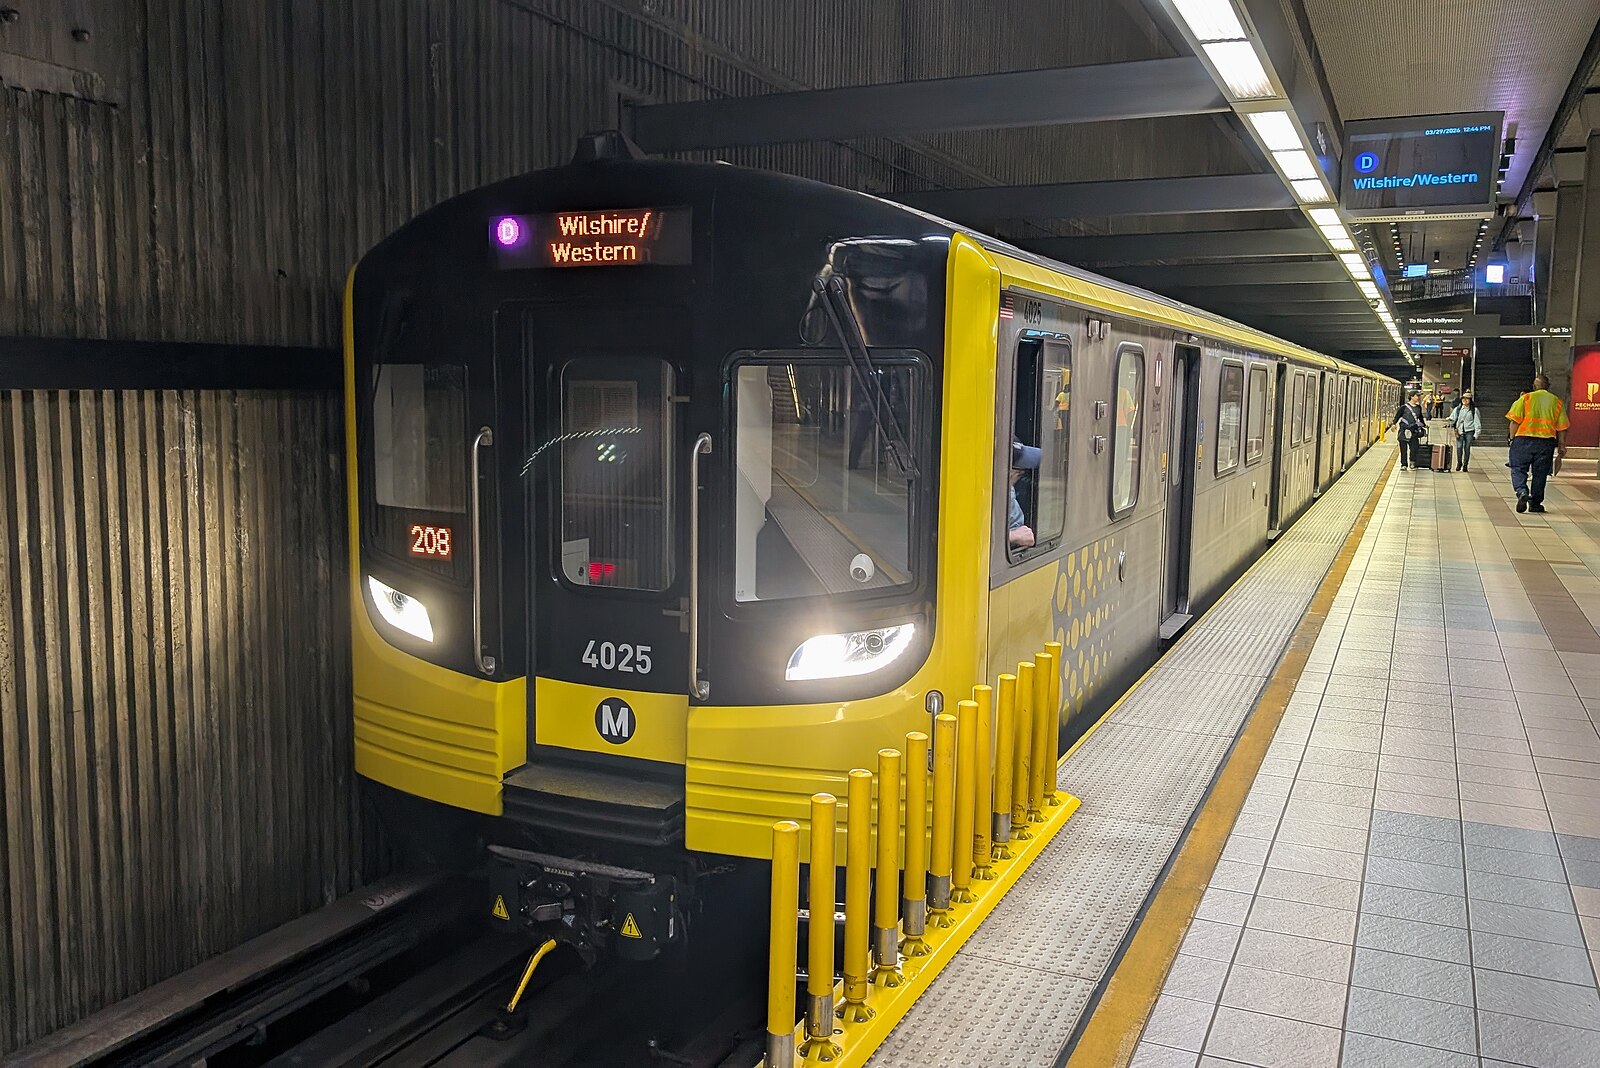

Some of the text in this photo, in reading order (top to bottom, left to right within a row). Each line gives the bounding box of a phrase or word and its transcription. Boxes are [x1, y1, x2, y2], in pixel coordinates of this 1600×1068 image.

[1425, 127, 1461, 136] 03/29/2026
[1361, 156, 1373, 169] D
[1353, 172, 1478, 190] Wilshire/Western
[501, 221, 514, 241] D
[558, 212, 652, 238] Wilshire/
[550, 241, 637, 263] Western
[1023, 299, 1042, 326] 4025
[1433, 317, 1463, 325] Hollywood
[411, 525, 450, 556] 208
[582, 640, 652, 674] 4025
[602, 704, 629, 738] M
